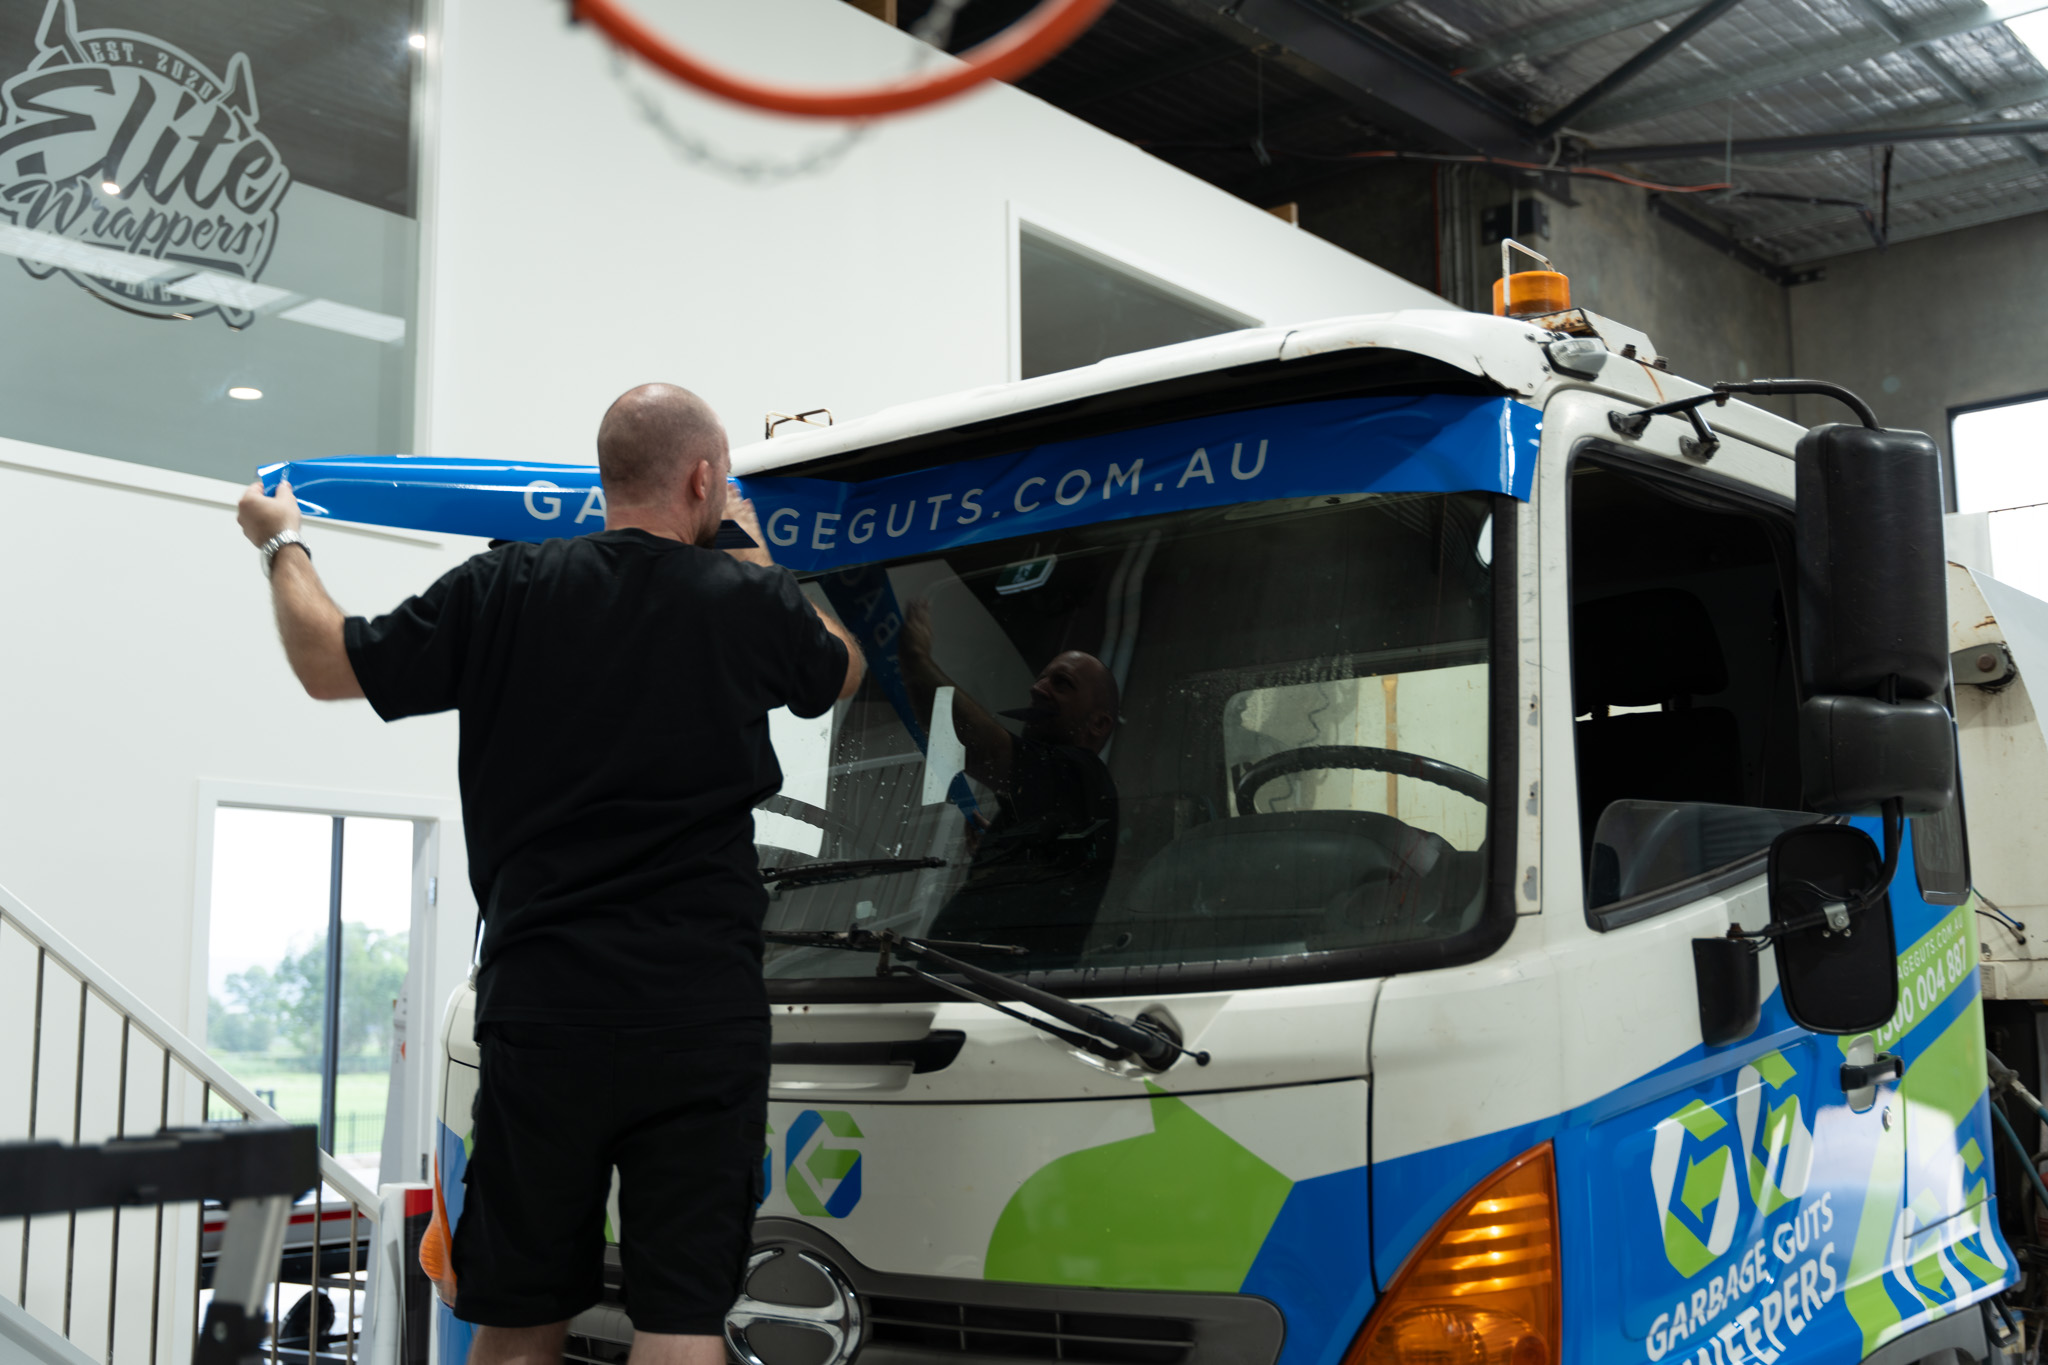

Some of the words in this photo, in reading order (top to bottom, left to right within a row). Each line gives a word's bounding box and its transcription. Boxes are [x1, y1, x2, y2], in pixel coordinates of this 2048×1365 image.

[89, 40, 143, 63] EST.
[156, 52, 214, 100] 2020
[0, 75, 274, 214] Elite
[2, 179, 256, 260] Wrappers
[523, 439, 1269, 550] GAGEGUTS.COM.AU
[1916, 958, 1945, 1011] 004
[1946, 935, 1966, 984] 887
[1645, 1238, 1772, 1362] GARBAGE
[1772, 1191, 1834, 1264] GUTS
